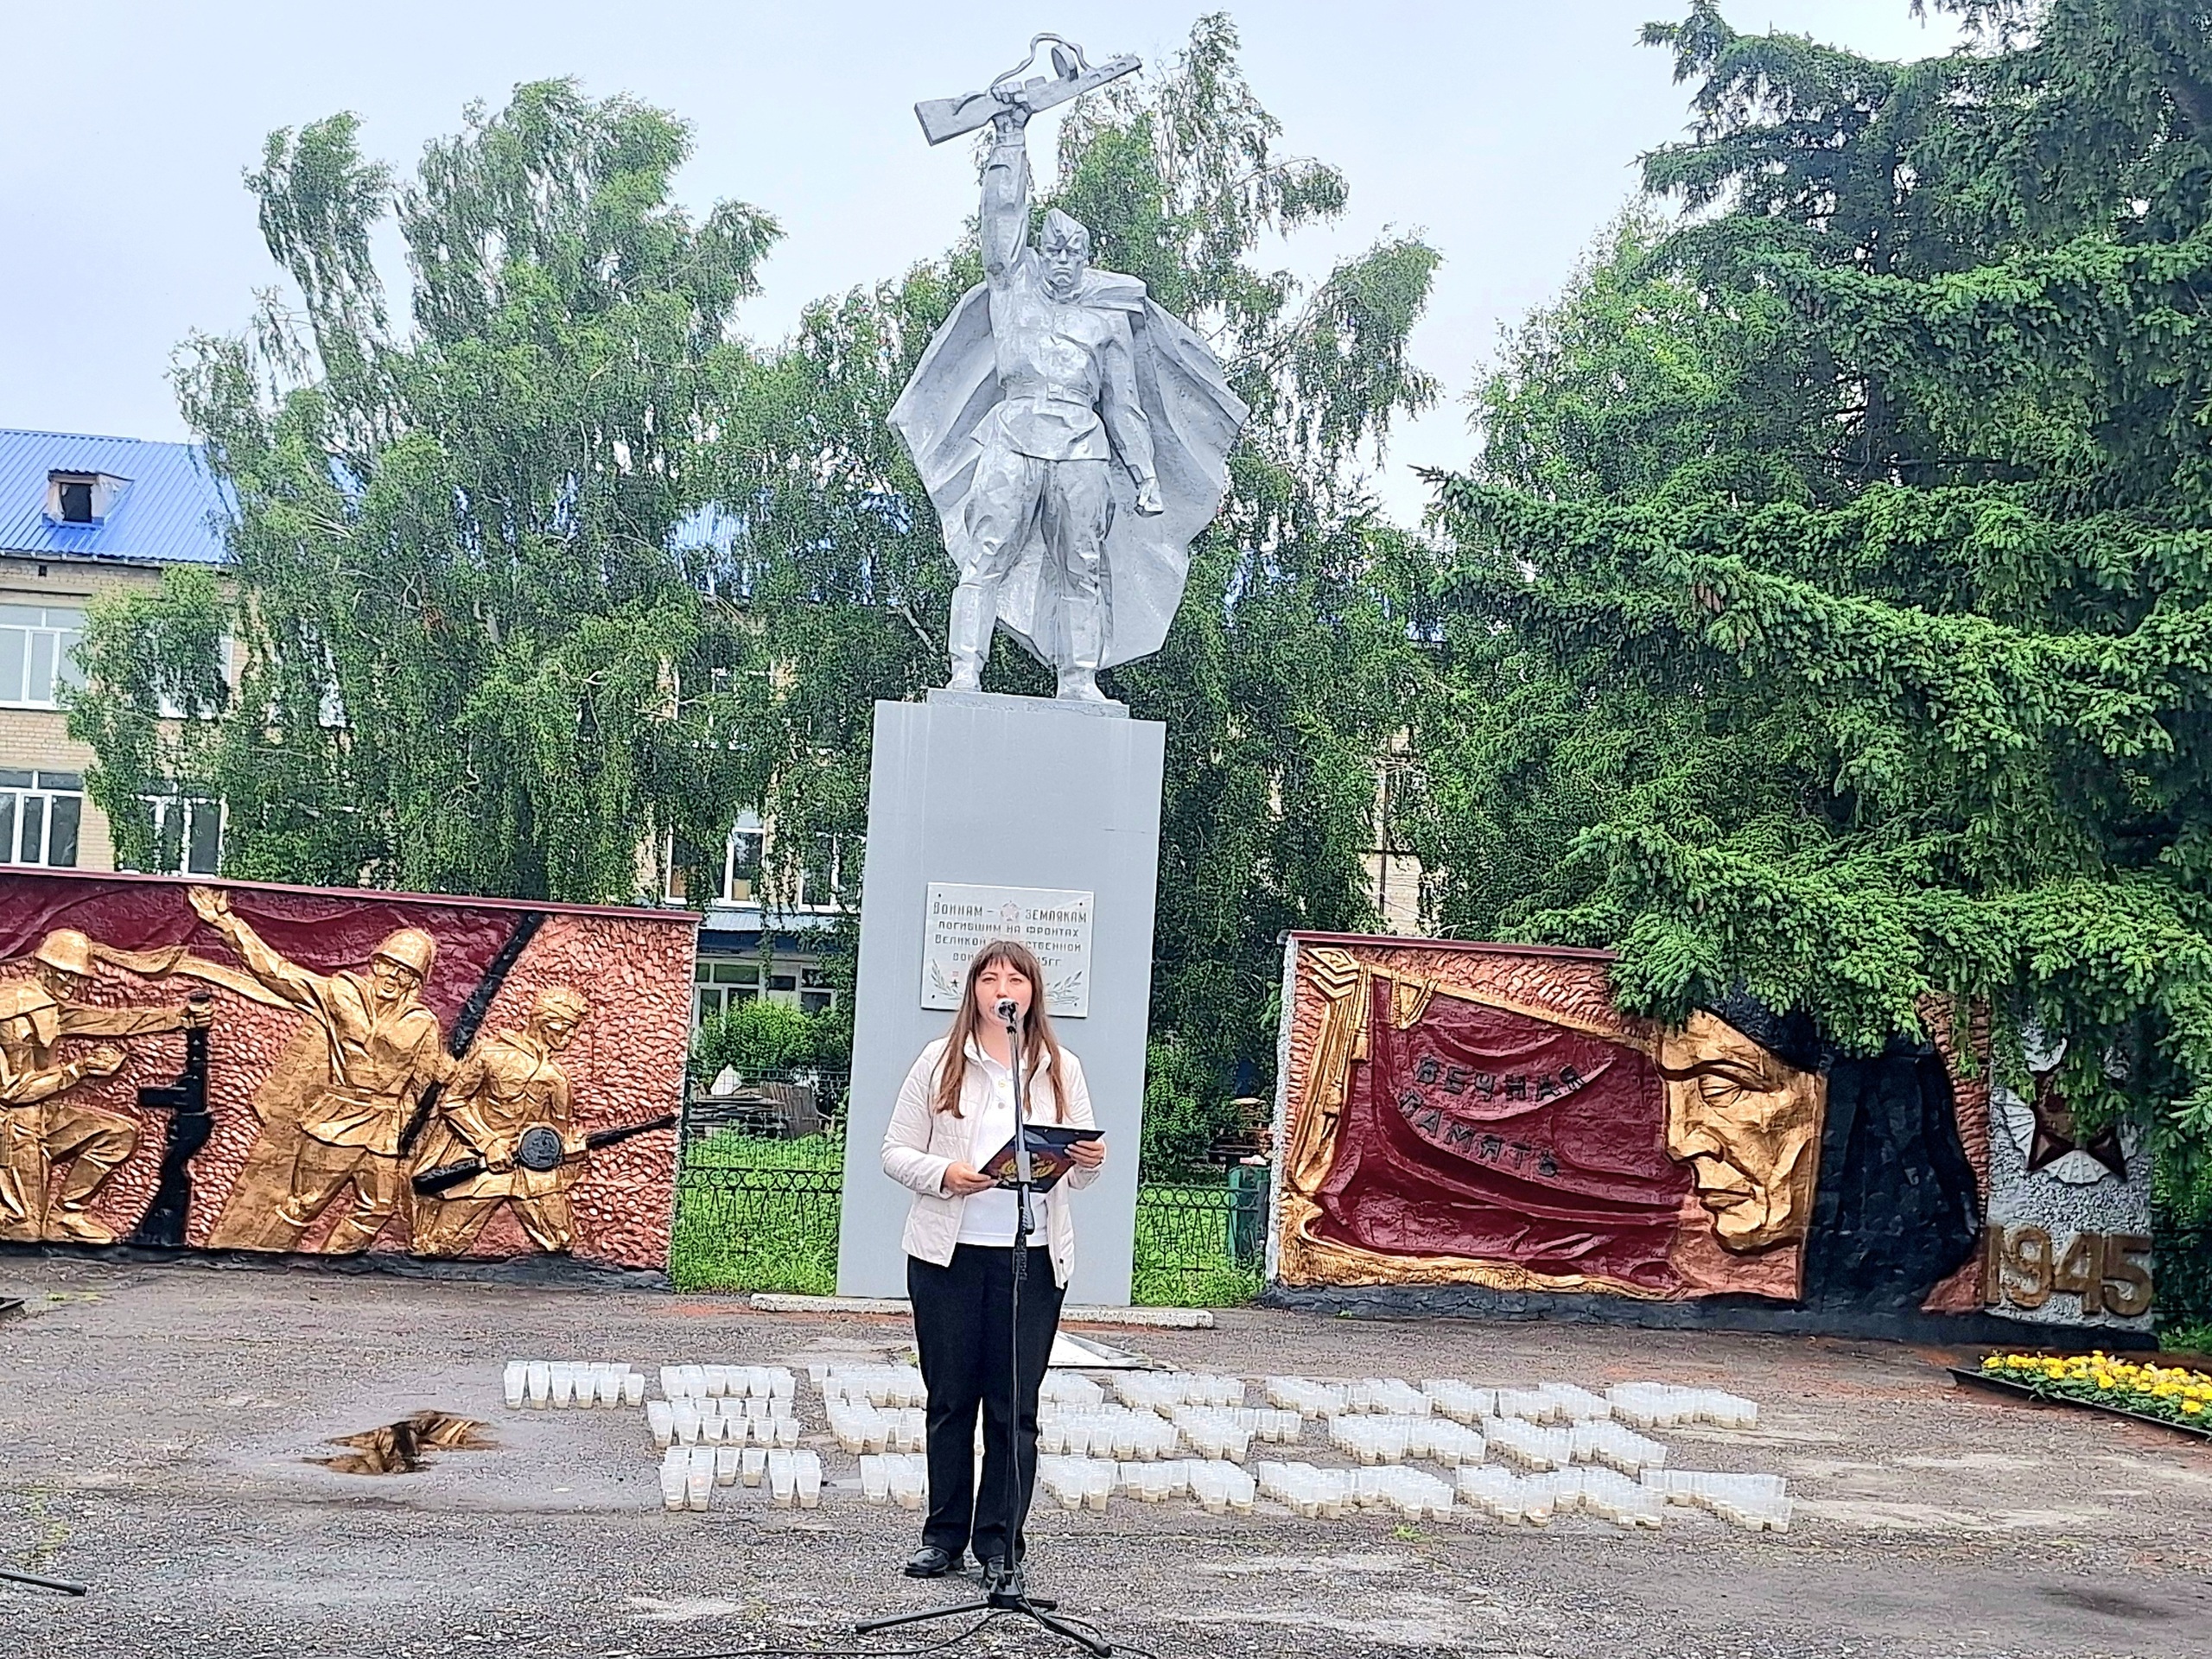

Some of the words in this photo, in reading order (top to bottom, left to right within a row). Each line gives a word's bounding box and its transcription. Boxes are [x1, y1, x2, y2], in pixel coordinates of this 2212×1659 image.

[933, 901, 983, 917] ВОИНАМ
[1025, 908, 1087, 924] ЗЕМЛЯКАМ
[938, 920, 1002, 933] ПОГИБШИМ
[1006, 925, 1021, 934] НА
[1026, 925, 1079, 938] ФРОНТАХ
[935, 933, 987, 947] ВЕЛИКОЙ
[990, 937, 1082, 952] СТВЕННОЙ
[1416, 1056, 1586, 1102] ВЕЧНАЯ
[1396, 1089, 1557, 1178] ПАМЯТЬ
[1980, 1224, 2154, 1318] 1945
